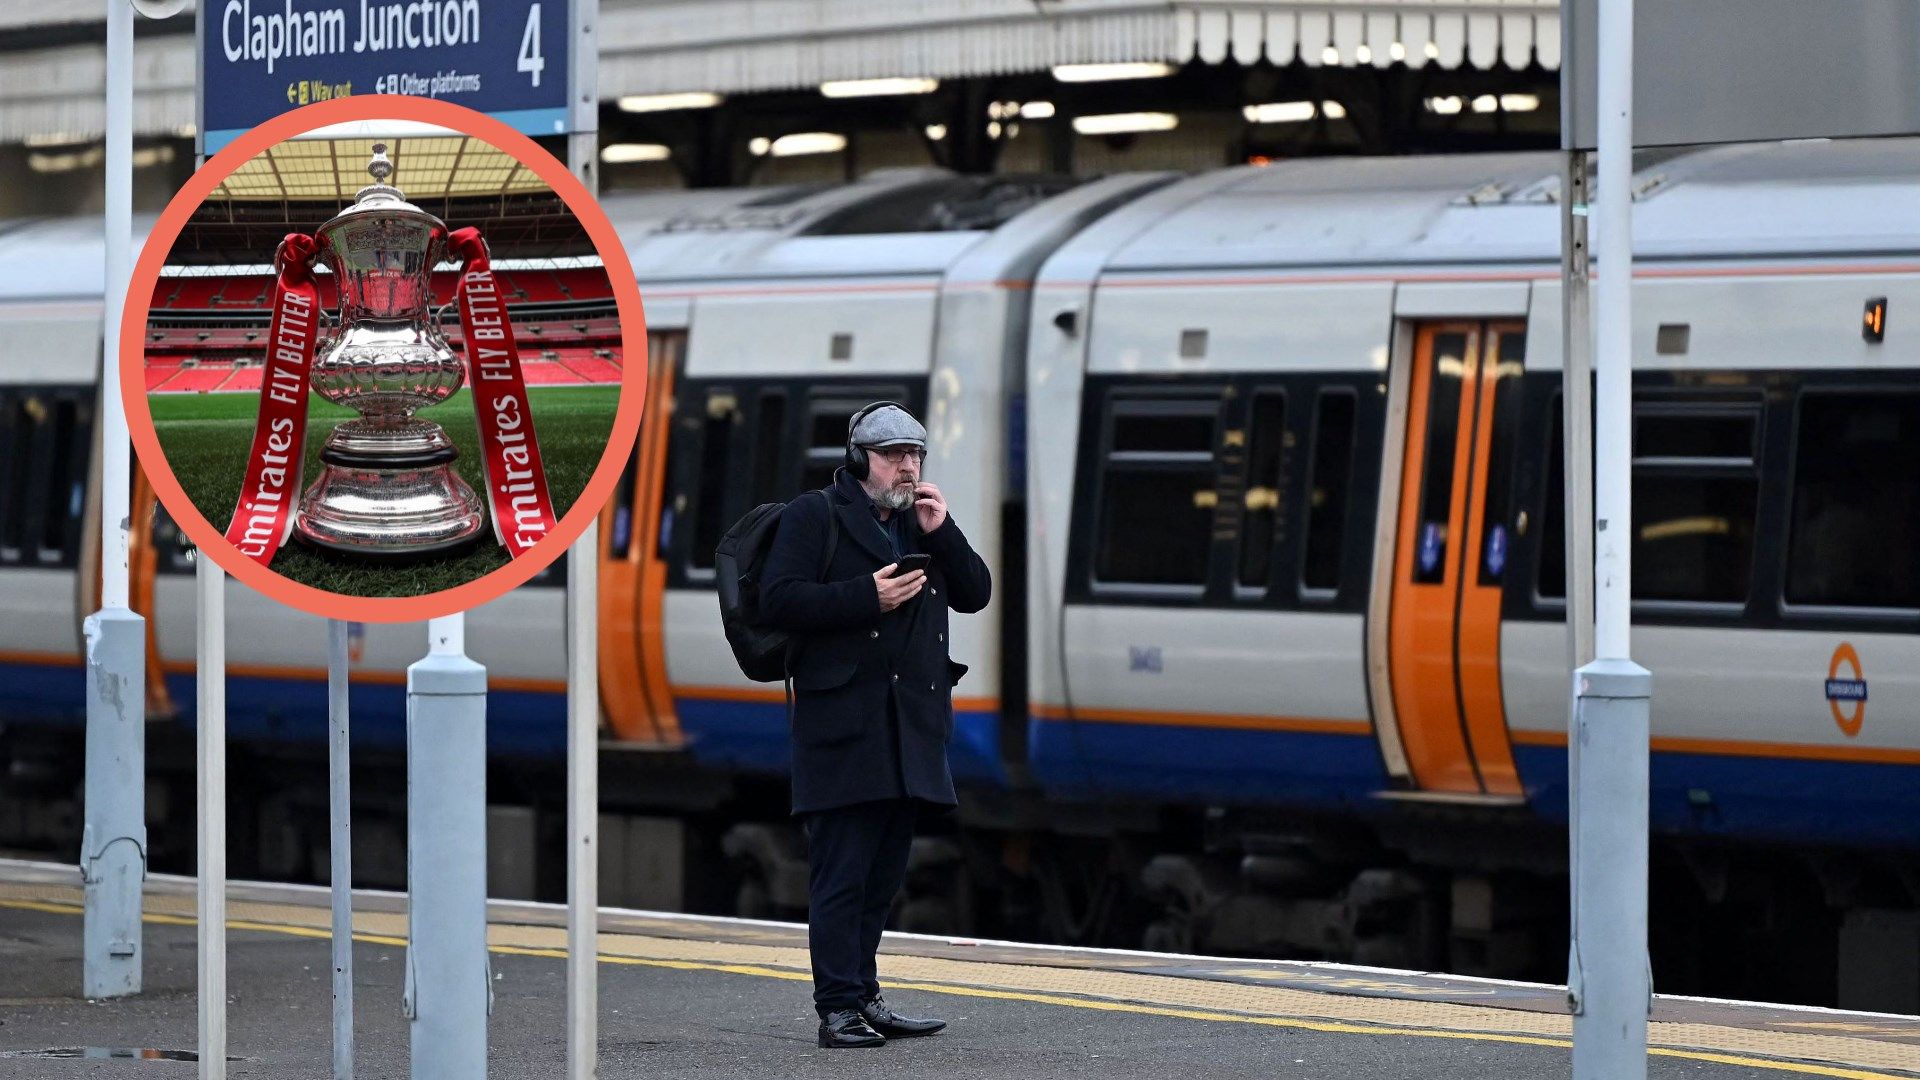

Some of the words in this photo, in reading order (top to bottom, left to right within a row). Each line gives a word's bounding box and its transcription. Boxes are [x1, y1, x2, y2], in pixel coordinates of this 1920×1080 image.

[222, 0, 346, 74] Clapham
[353, 0, 480, 53] Junction
[517, 3, 545, 87] 4
[311, 81, 333, 101] Way
[334, 80, 352, 97] out
[400, 73, 430, 95] Other
[430, 70, 481, 98] platforms
[276, 291, 312, 364] BETTER
[465, 270, 505, 339] BETTER
[270, 366, 301, 404] FLY
[478, 347, 513, 380] FLY
